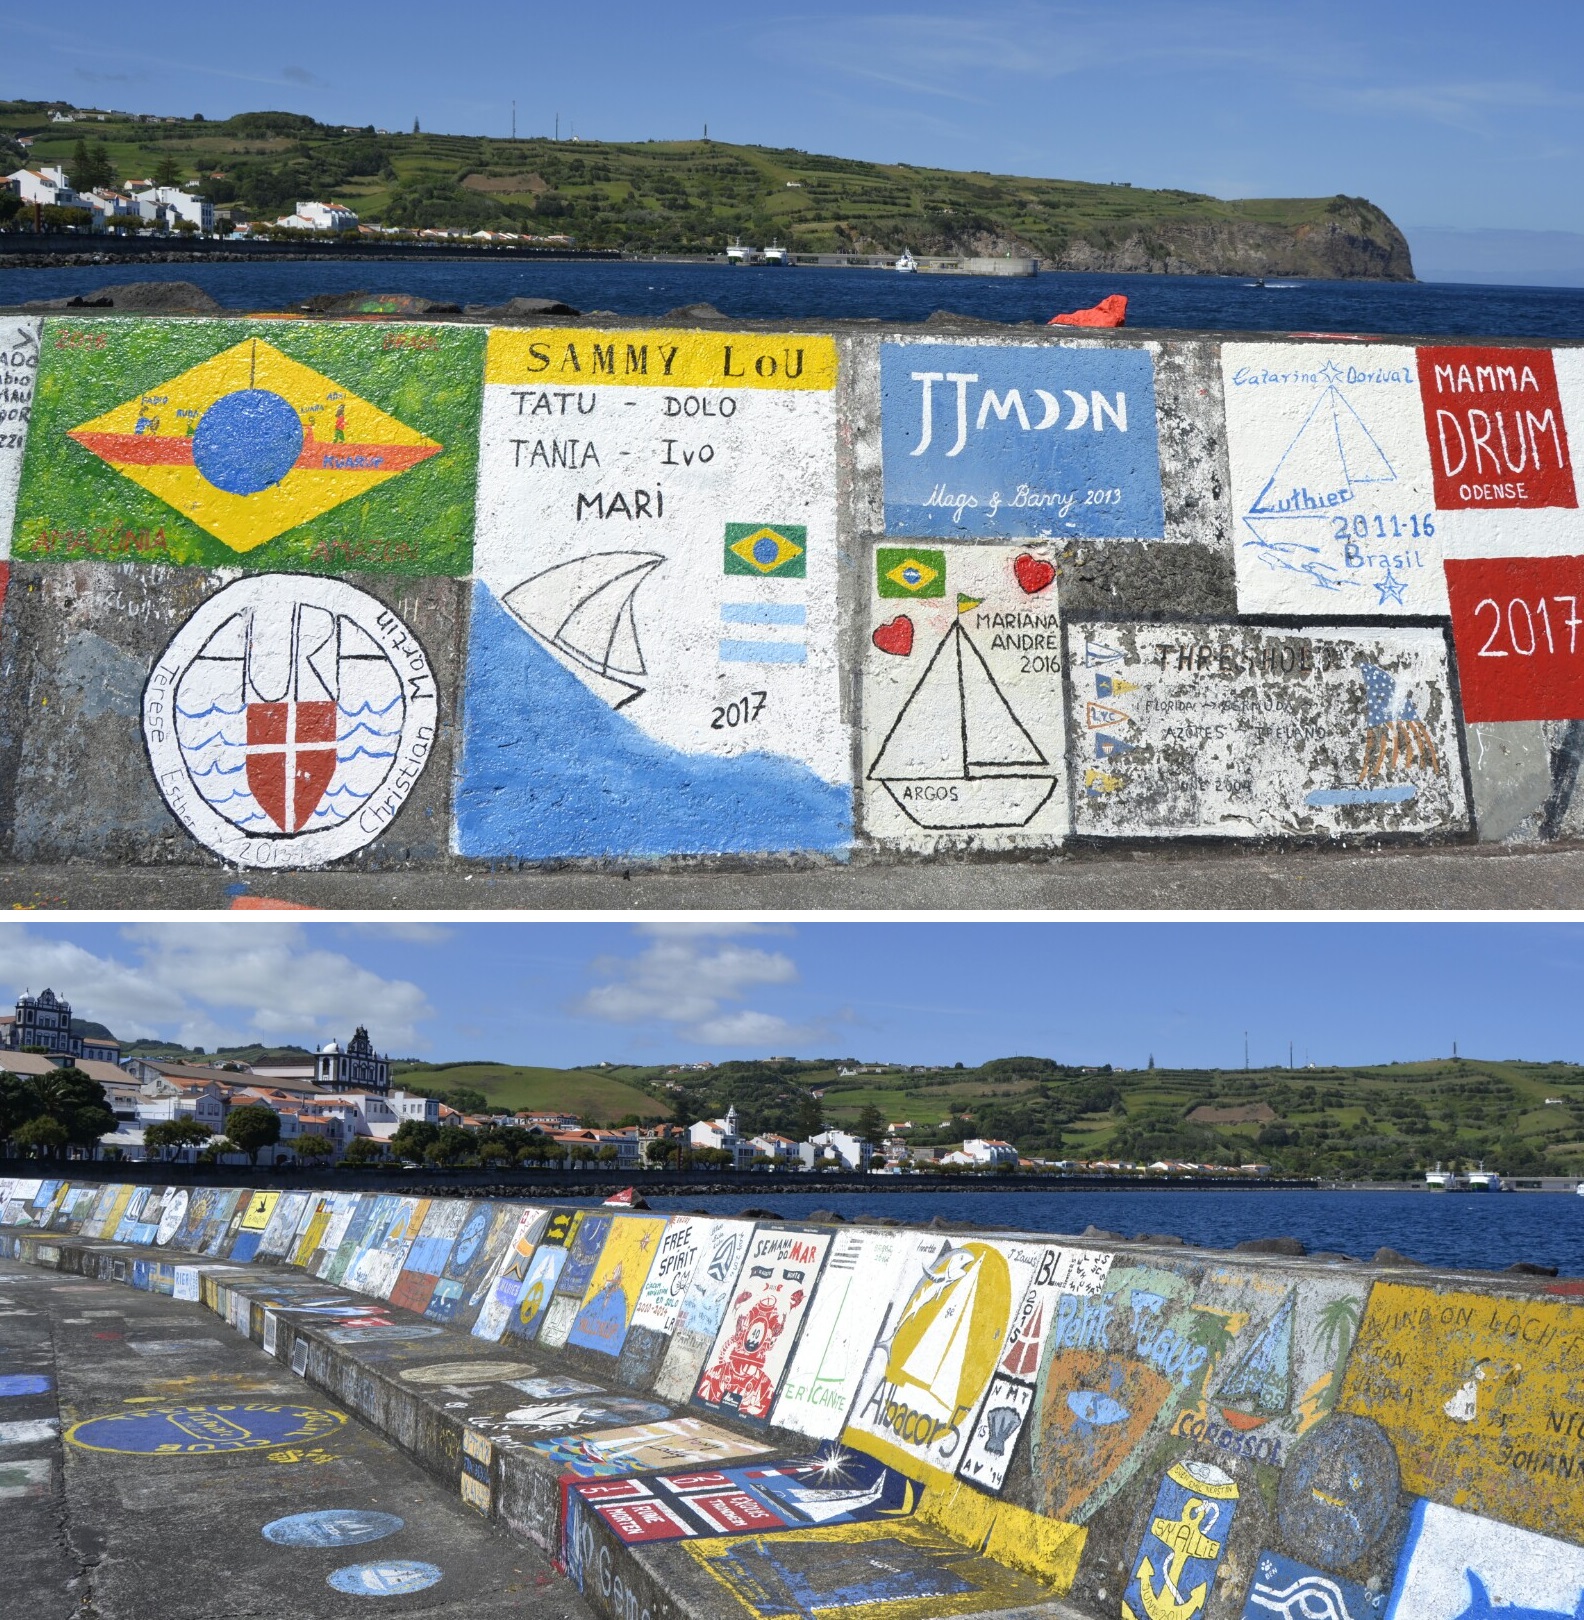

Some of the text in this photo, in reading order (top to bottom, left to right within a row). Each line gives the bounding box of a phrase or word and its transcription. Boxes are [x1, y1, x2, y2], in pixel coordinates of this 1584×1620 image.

[526, 342, 679, 376] SAMMY
[1347, 366, 1415, 384] Dorival
[1434, 364, 1539, 393] MAMMA
[510, 391, 596, 415] TATU
[663, 396, 737, 417] DOLO
[510, 438, 601, 469] TANIA
[1436, 408, 1564, 477] DRUM
[922, 483, 978, 523] Mags
[988, 491, 1002, 518] &
[1084, 489, 1121, 505] 2013
[1249, 477, 1354, 513] Luthier
[1460, 482, 1528, 501] ODENSE
[1332, 513, 1436, 539] 2011-16
[1344, 543, 1424, 568] Brasil
[977, 612, 1059, 629] MARIANA
[1475, 596, 1583, 657] 2017
[376, 610, 434, 702] Martin
[1020, 656, 1061, 673] 2016
[1155, 643, 1332, 673] THRESHOLD
[710, 690, 768, 730] 2017
[359, 725, 435, 834] Christian
[903, 785, 959, 801] ARGOS
[662, 1226, 693, 1255] FREE
[753, 1239, 793, 1258] SEMANA
[777, 1250, 789, 1261] DO
[788, 1241, 817, 1264] MAR
[606, 1507, 646, 1535] MORTEN
[1264, 1567, 1278, 1581] BEN
